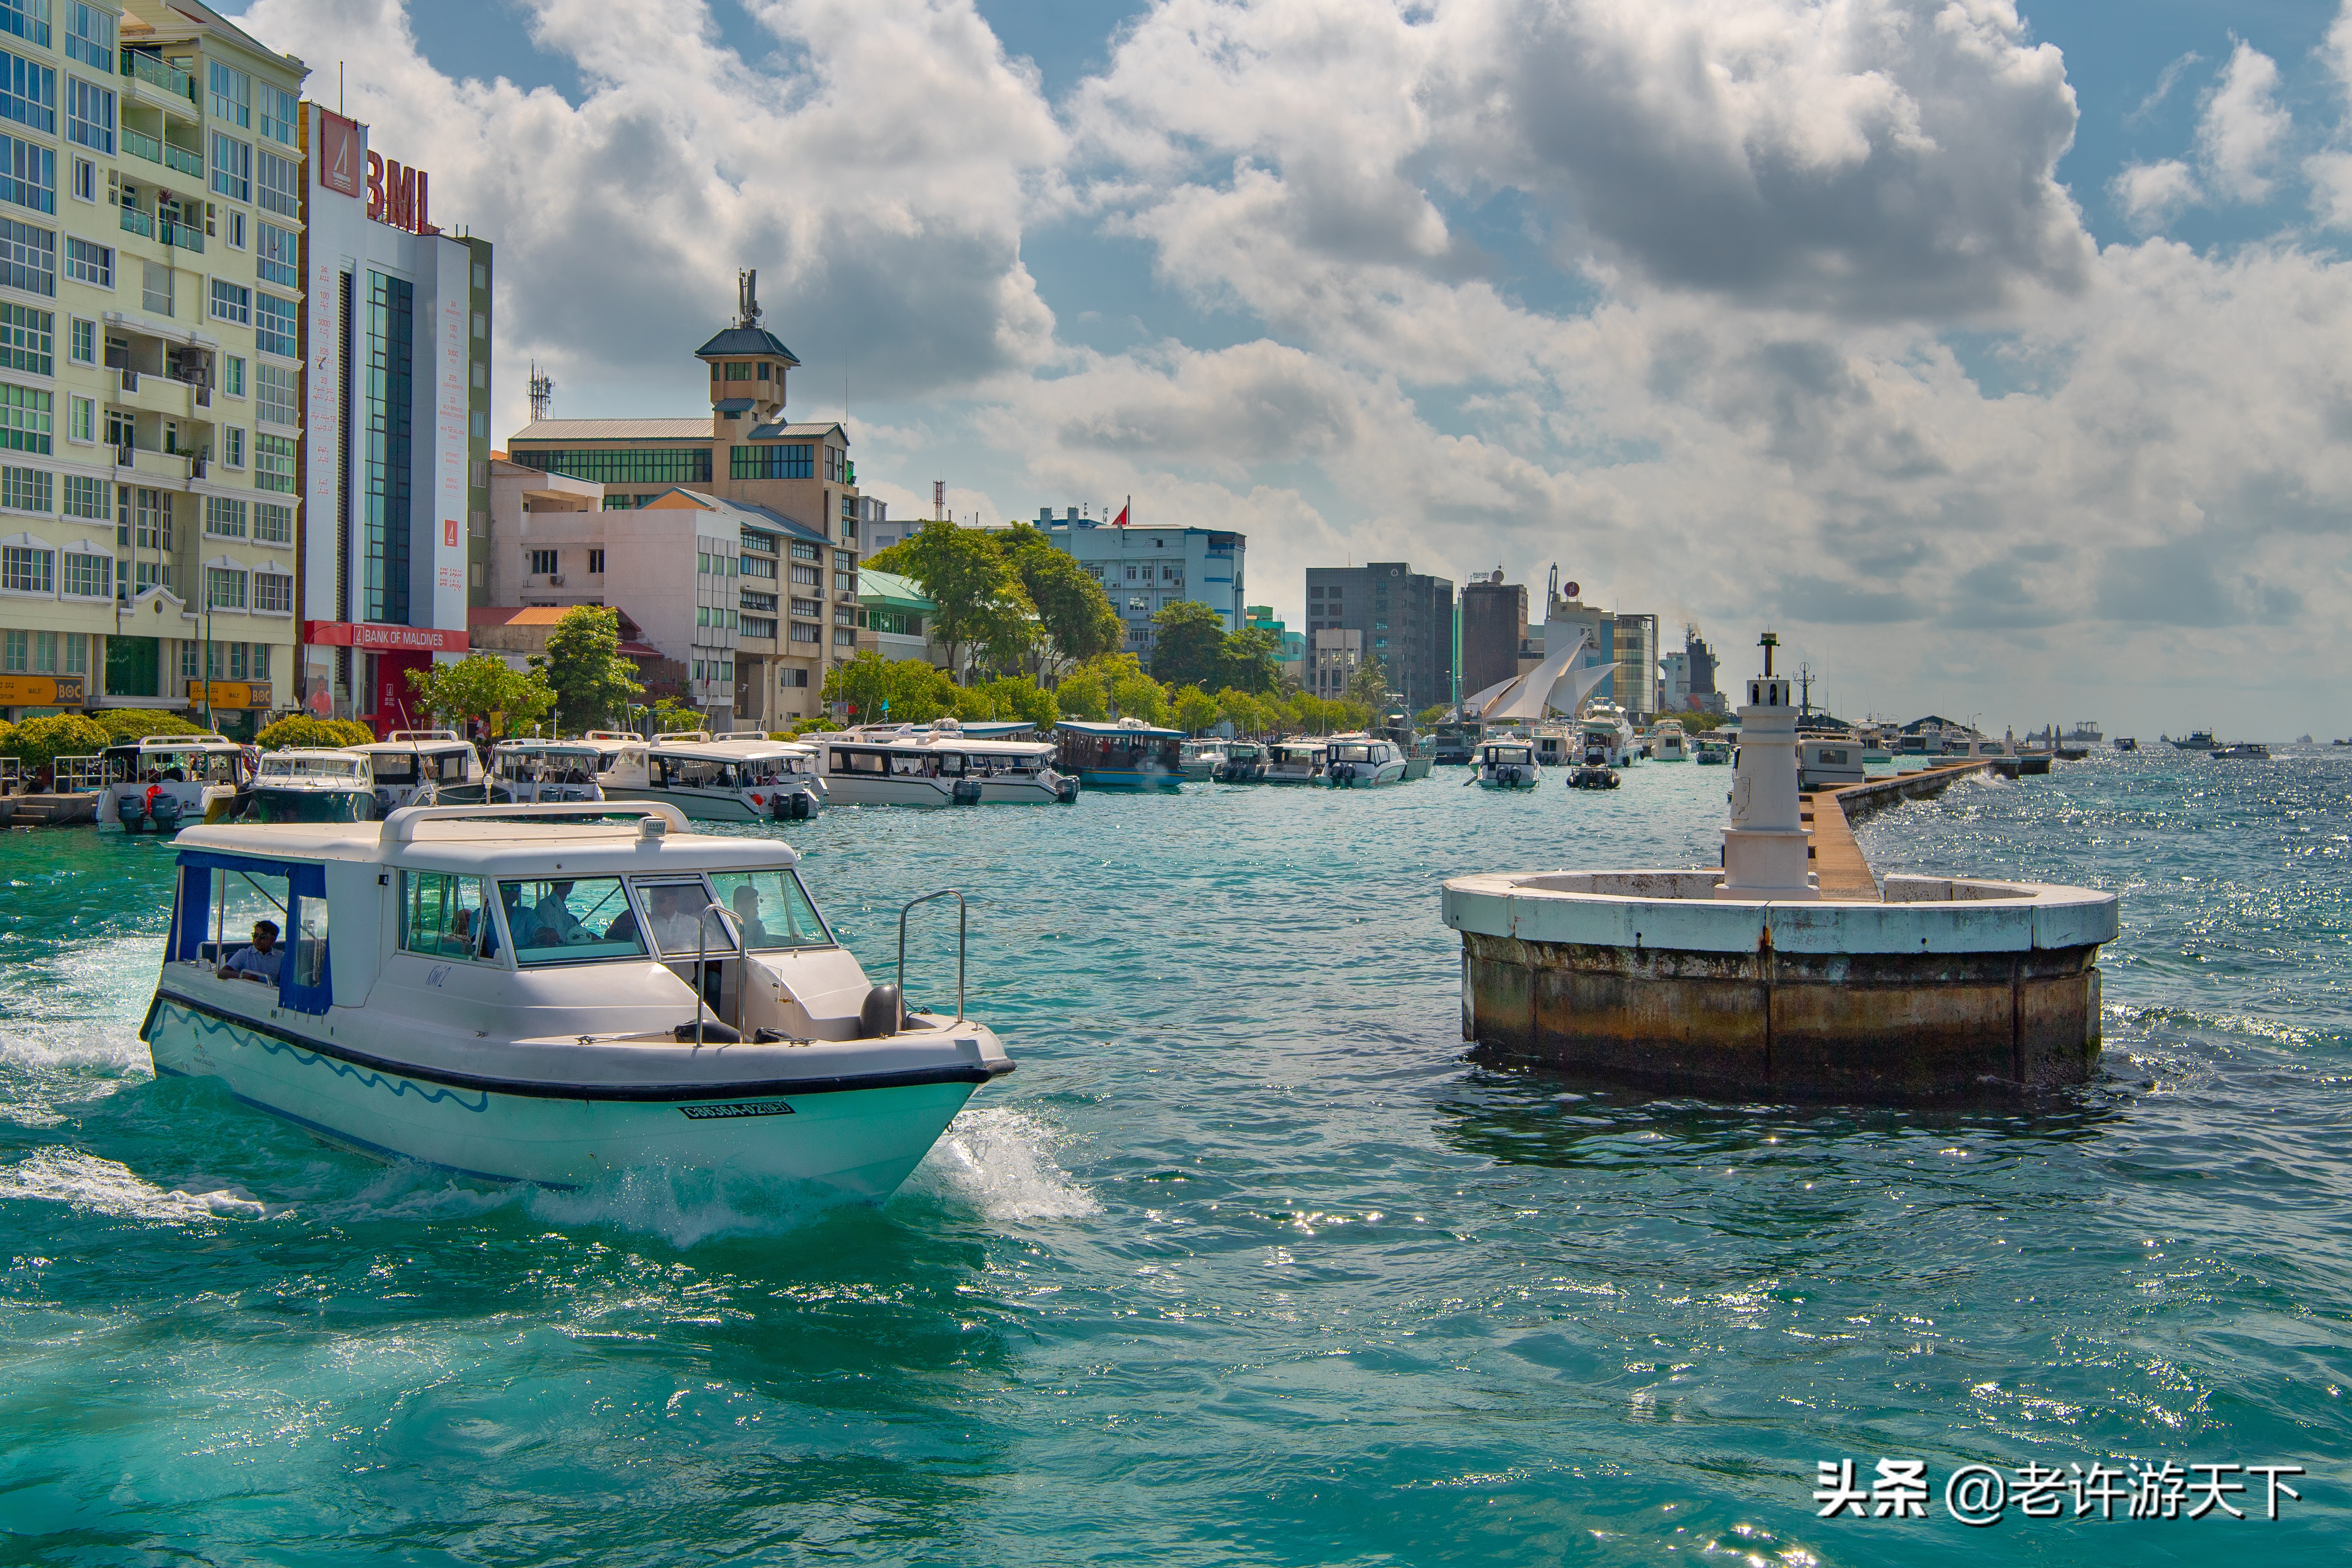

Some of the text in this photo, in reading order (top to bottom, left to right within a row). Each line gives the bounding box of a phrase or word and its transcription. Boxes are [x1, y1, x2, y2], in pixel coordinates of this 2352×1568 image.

[320, 291, 329, 300] 100
[445, 308, 461, 317] BRANCHES
[318, 318, 330, 327] 5000
[319, 347, 329, 356] 205
[448, 349, 458, 357] 5000
[365, 629, 443, 646] BANK OF MALDIVES
[59, 684, 81, 698] BOC
[253, 690, 270, 702] BOC
[684, 1104, 766, 1118] C8636A-02
